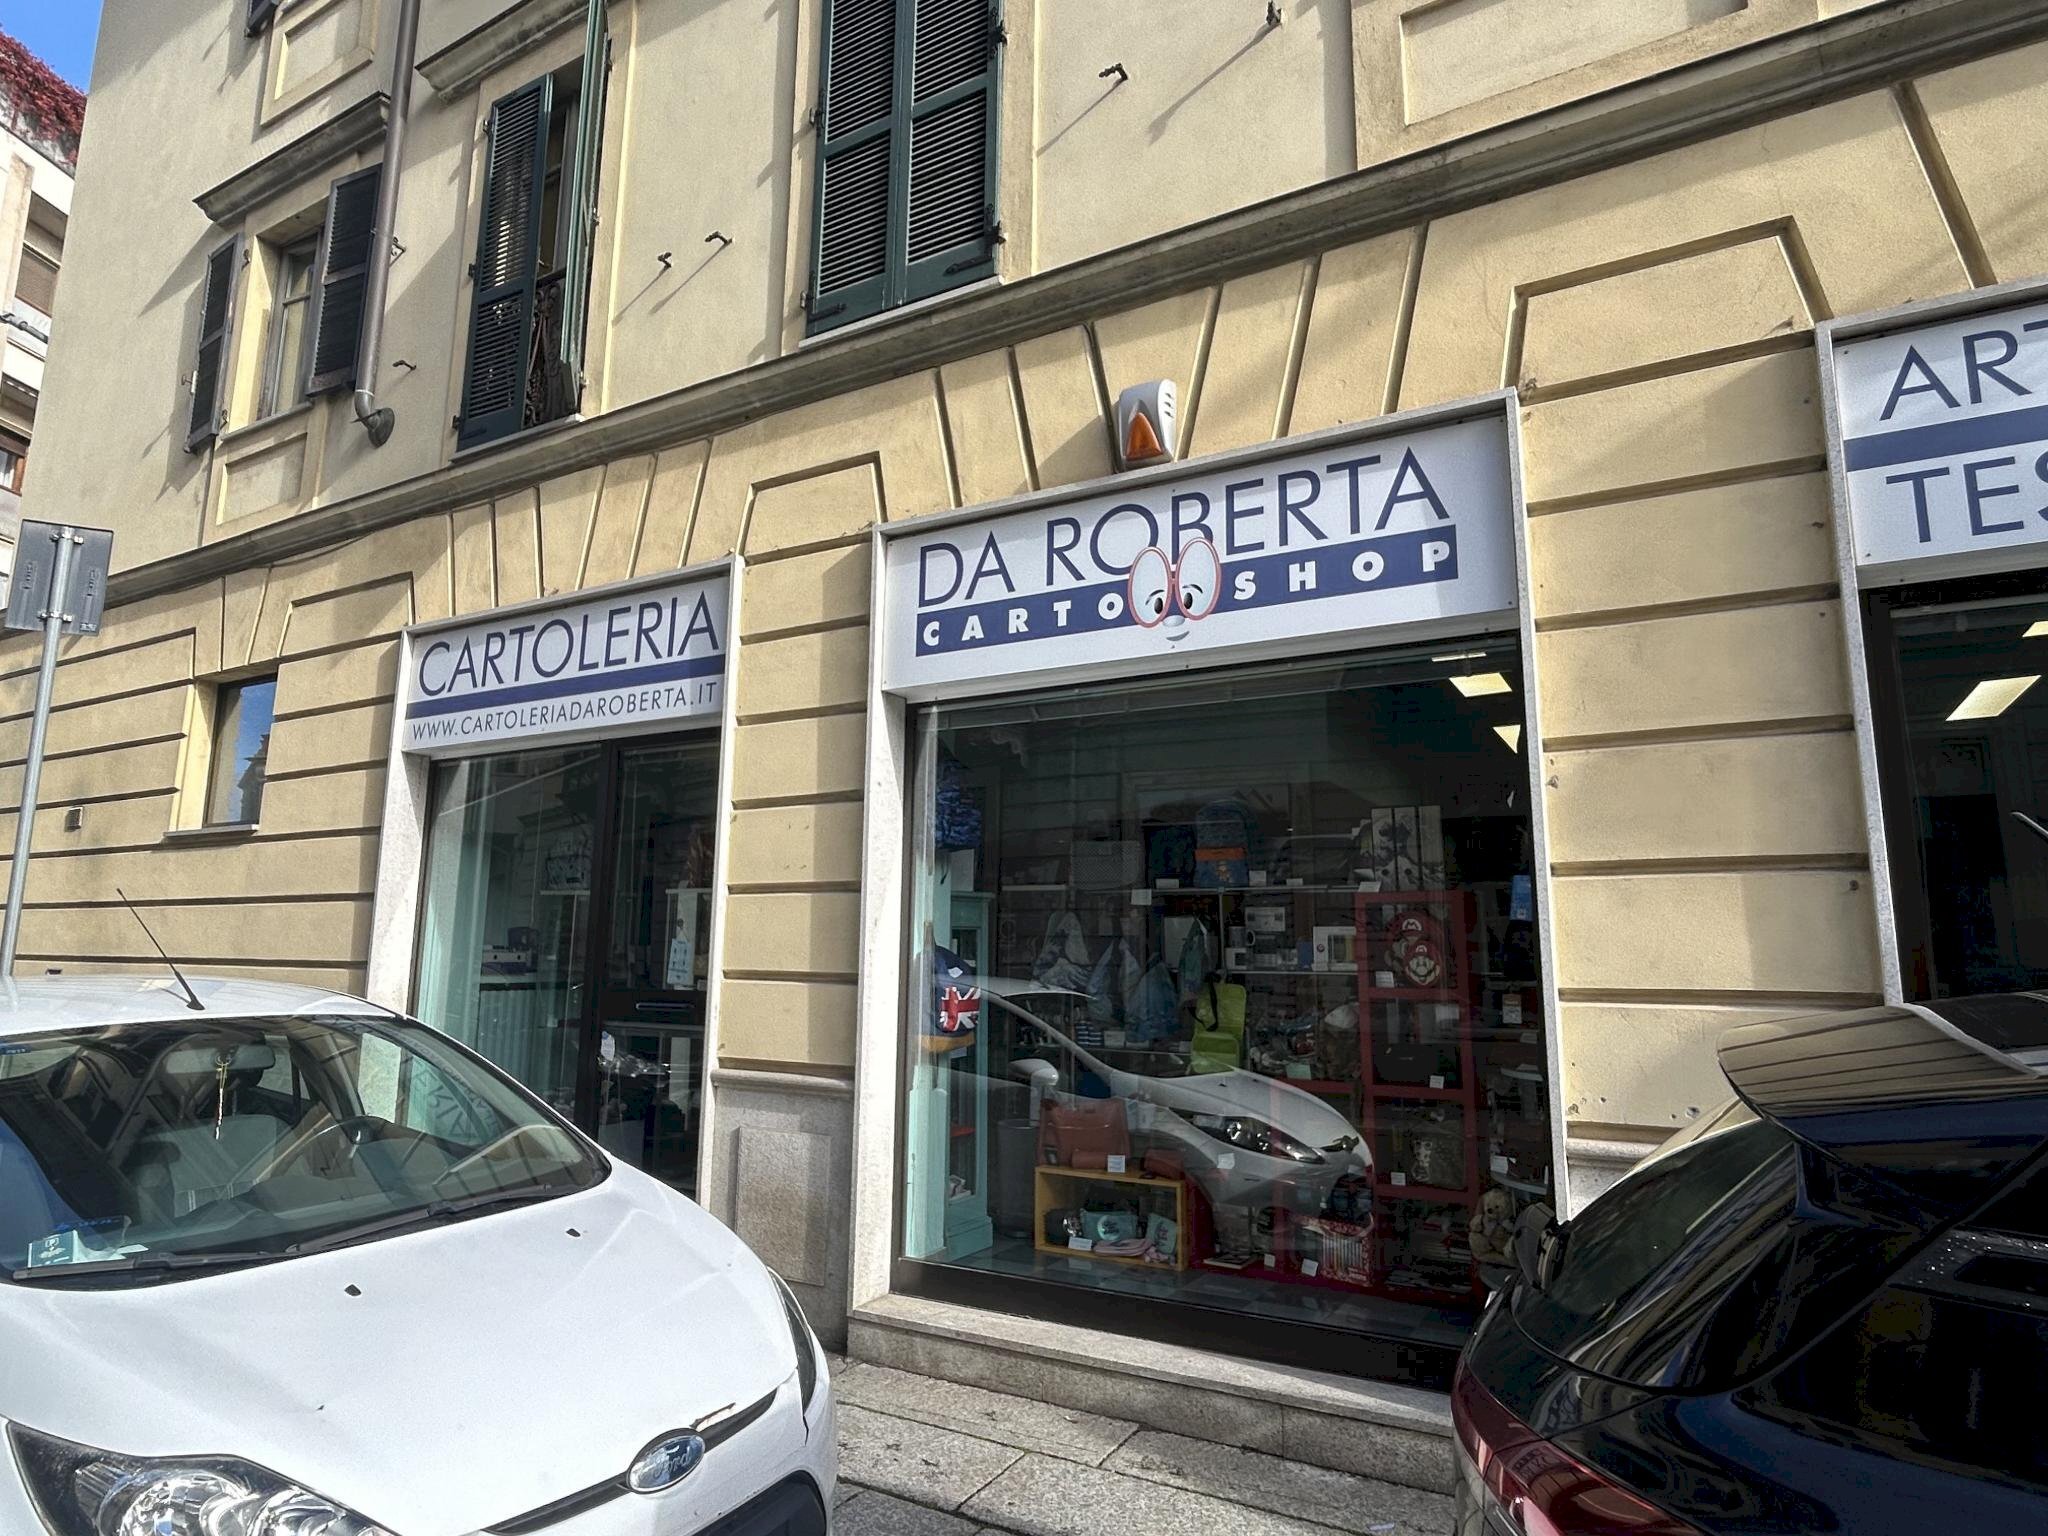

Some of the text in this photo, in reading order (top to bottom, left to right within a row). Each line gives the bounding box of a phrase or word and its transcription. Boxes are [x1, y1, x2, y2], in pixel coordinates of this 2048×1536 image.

[918, 446, 1450, 608] DA ROBERTA
[419, 590, 720, 697] CARTOLERIA
[923, 541, 1450, 647] CARTO SHOP
[412, 681, 718, 741] WWW.CARTOLERIADAROBERTA.IT
